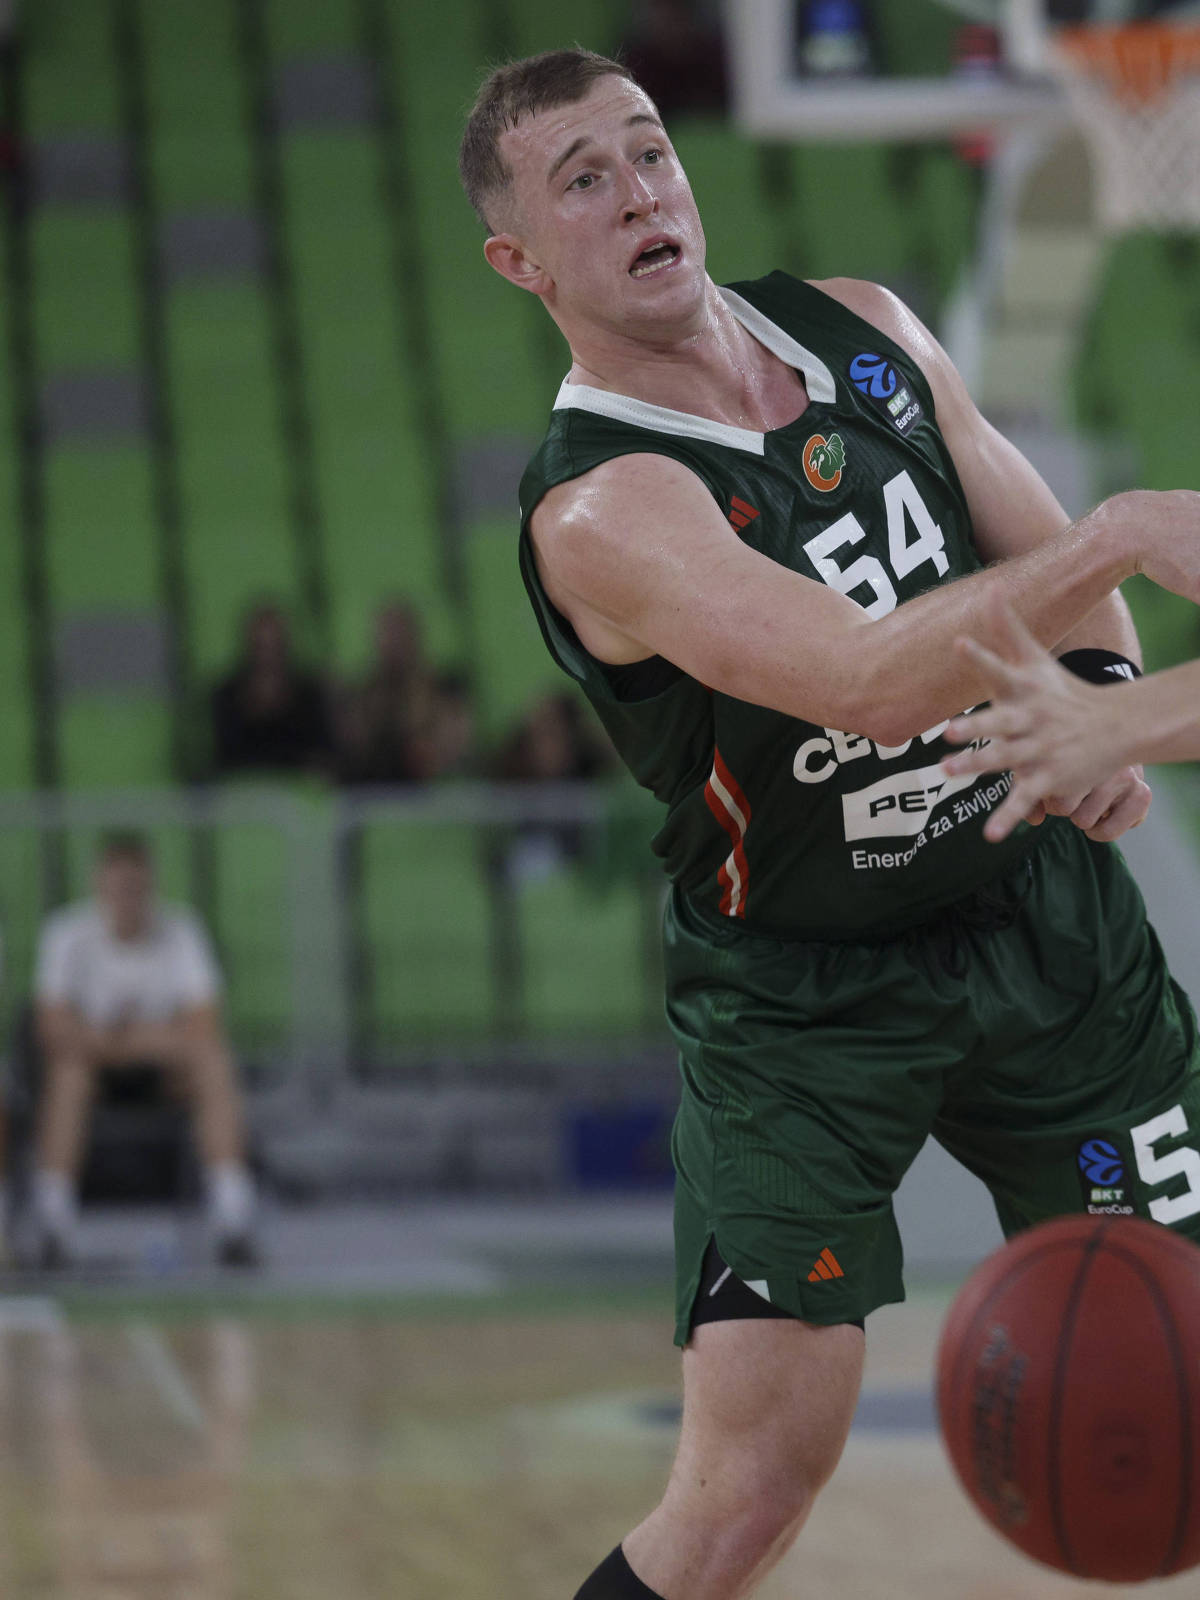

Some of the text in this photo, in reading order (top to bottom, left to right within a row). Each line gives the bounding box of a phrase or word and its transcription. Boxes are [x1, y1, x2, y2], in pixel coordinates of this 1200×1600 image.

[887, 388, 910, 416] BKT
[895, 403, 920, 430] EuroCup
[802, 469, 950, 622] 54
[929, 815, 955, 839] za
[1090, 1188, 1124, 1202] BKT
[1087, 1204, 1134, 1216] EuroCup
